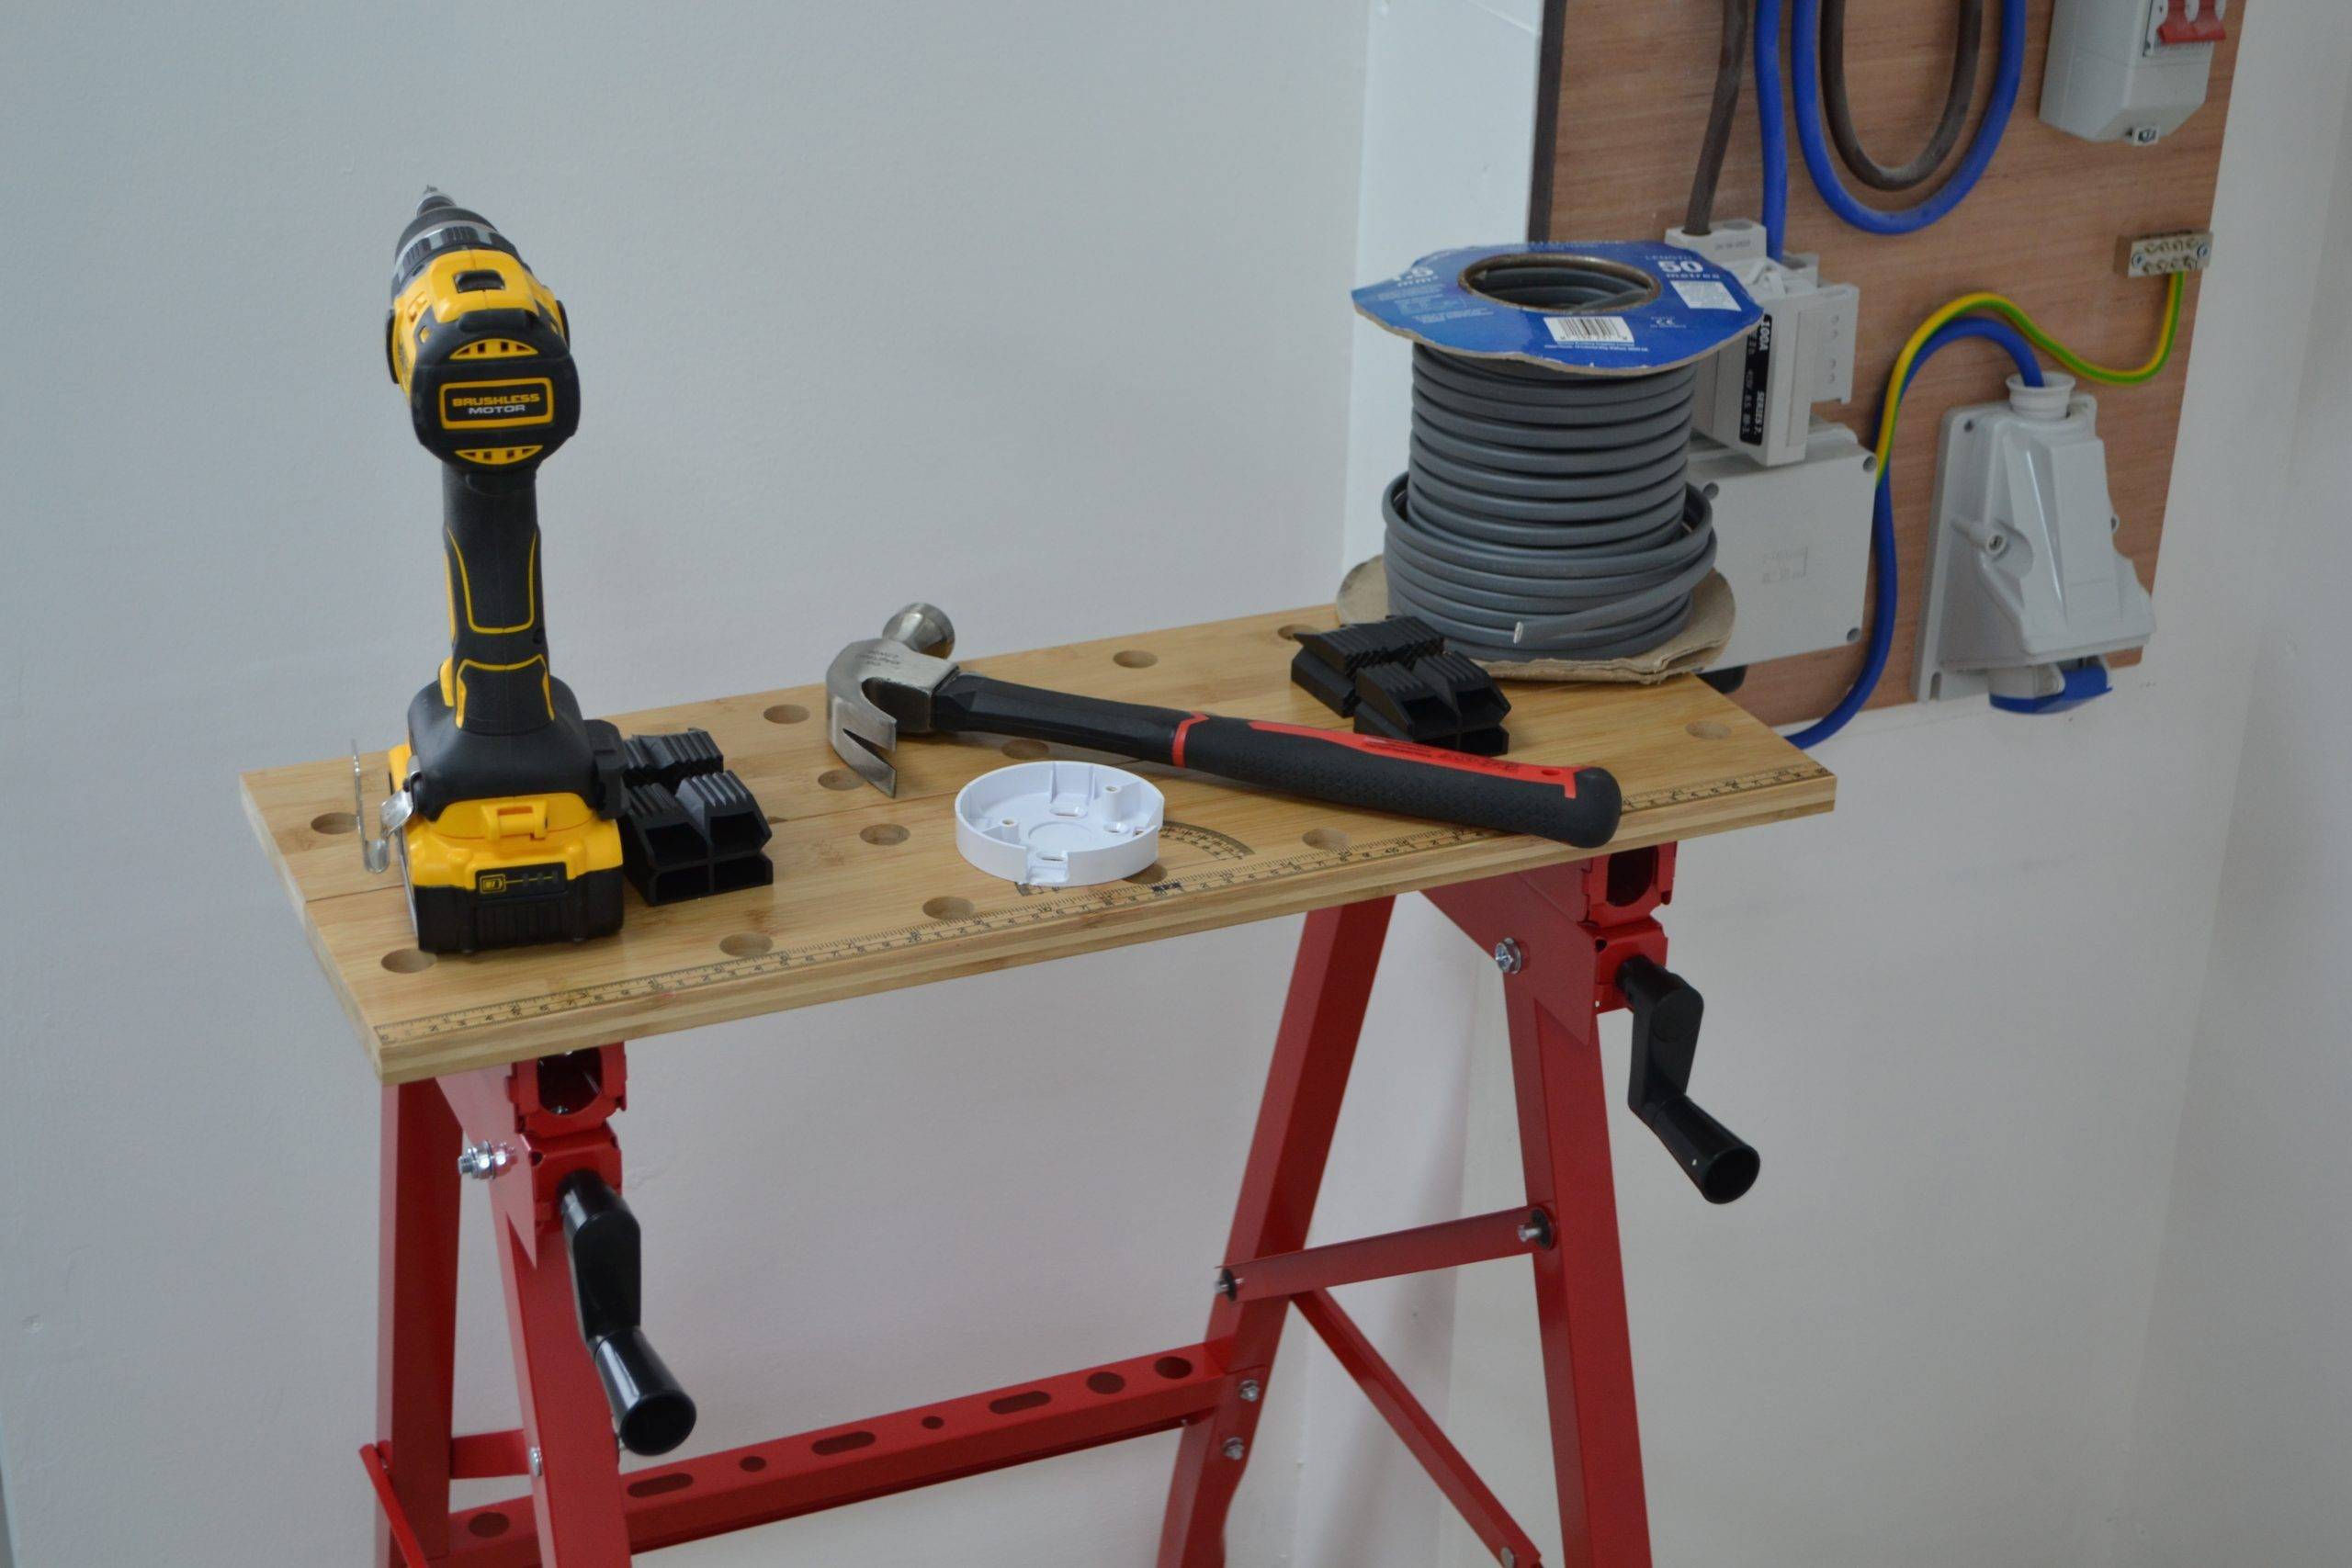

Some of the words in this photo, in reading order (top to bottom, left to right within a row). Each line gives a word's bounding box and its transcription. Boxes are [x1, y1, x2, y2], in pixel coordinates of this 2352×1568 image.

[1657, 260, 1704, 274] 50
[1758, 321, 1770, 352] 100A
[451, 393, 541, 407] BRUSHLESS
[468, 404, 527, 415] MOTOR
[1754, 390, 1765, 426] SERIES
